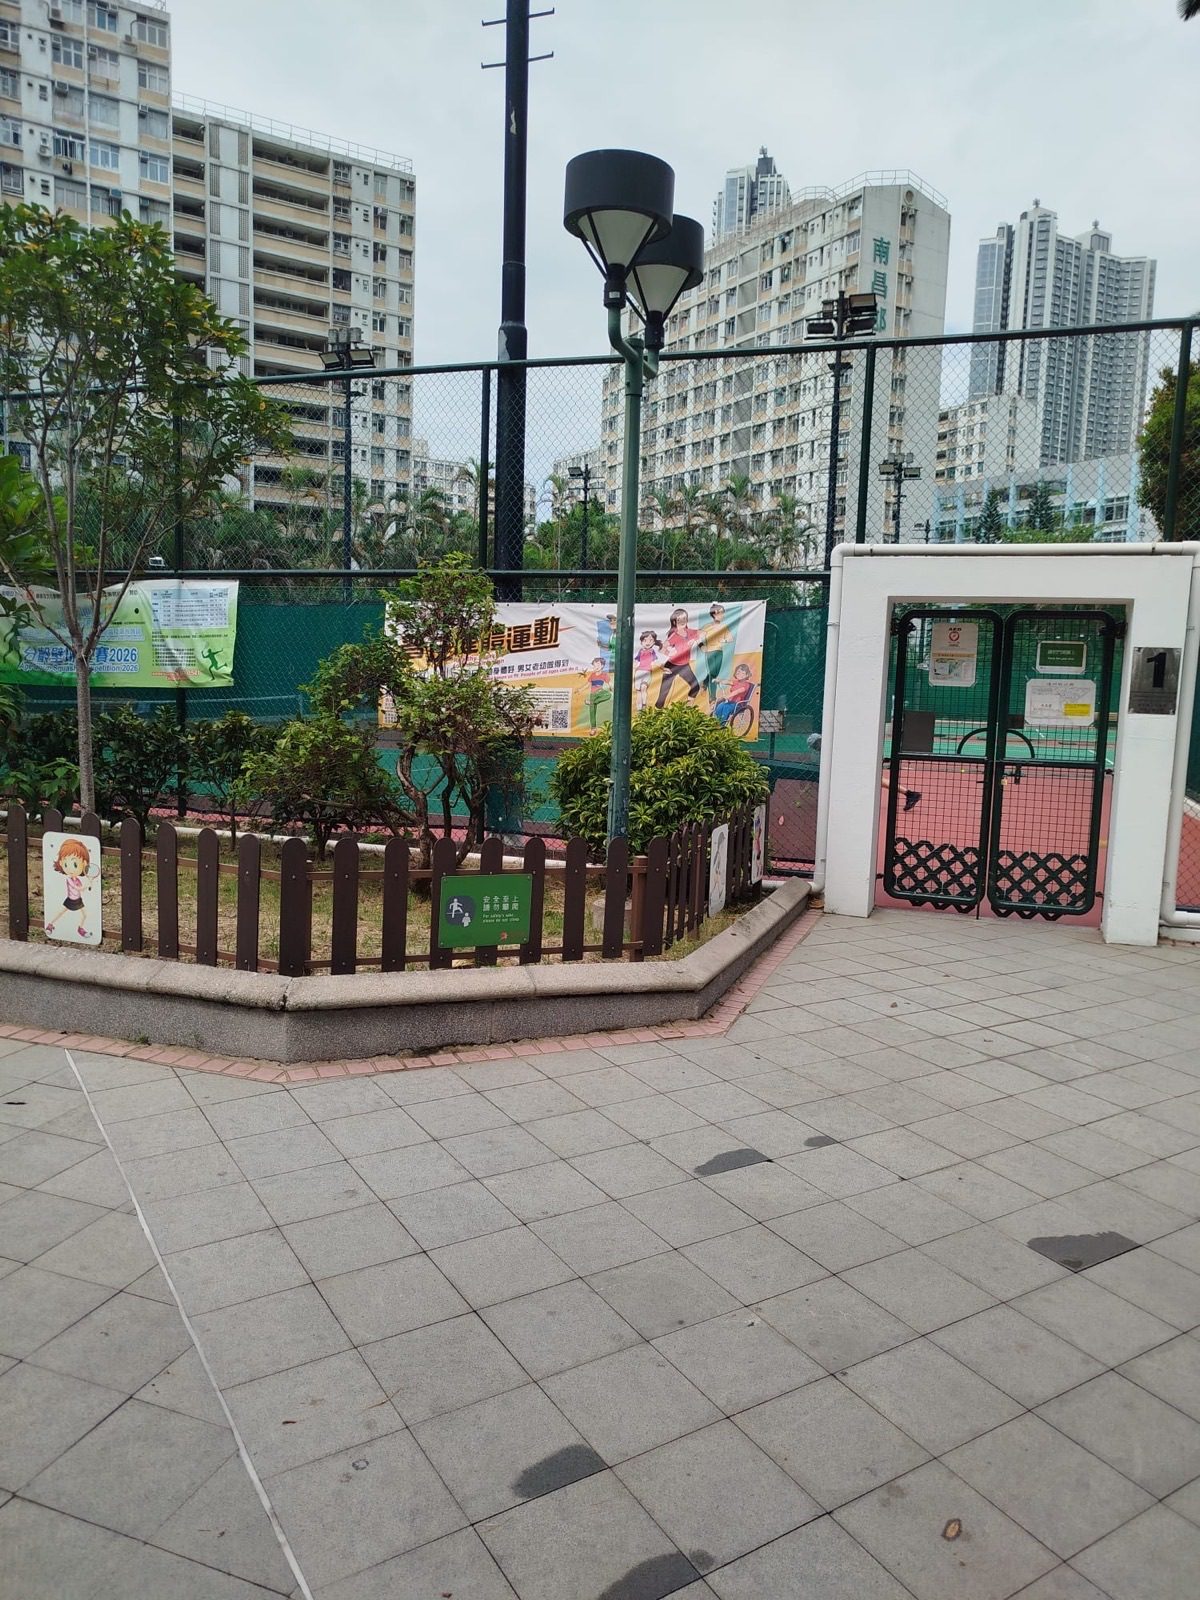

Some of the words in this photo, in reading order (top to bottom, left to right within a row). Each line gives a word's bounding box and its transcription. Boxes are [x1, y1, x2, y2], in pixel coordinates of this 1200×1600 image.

[24, 646, 138, 662] 分齡壁球賽2026
[122, 664, 138, 672] 2026
[1146, 652, 1167, 688] 1
[482, 895, 519, 903] 安全至上
